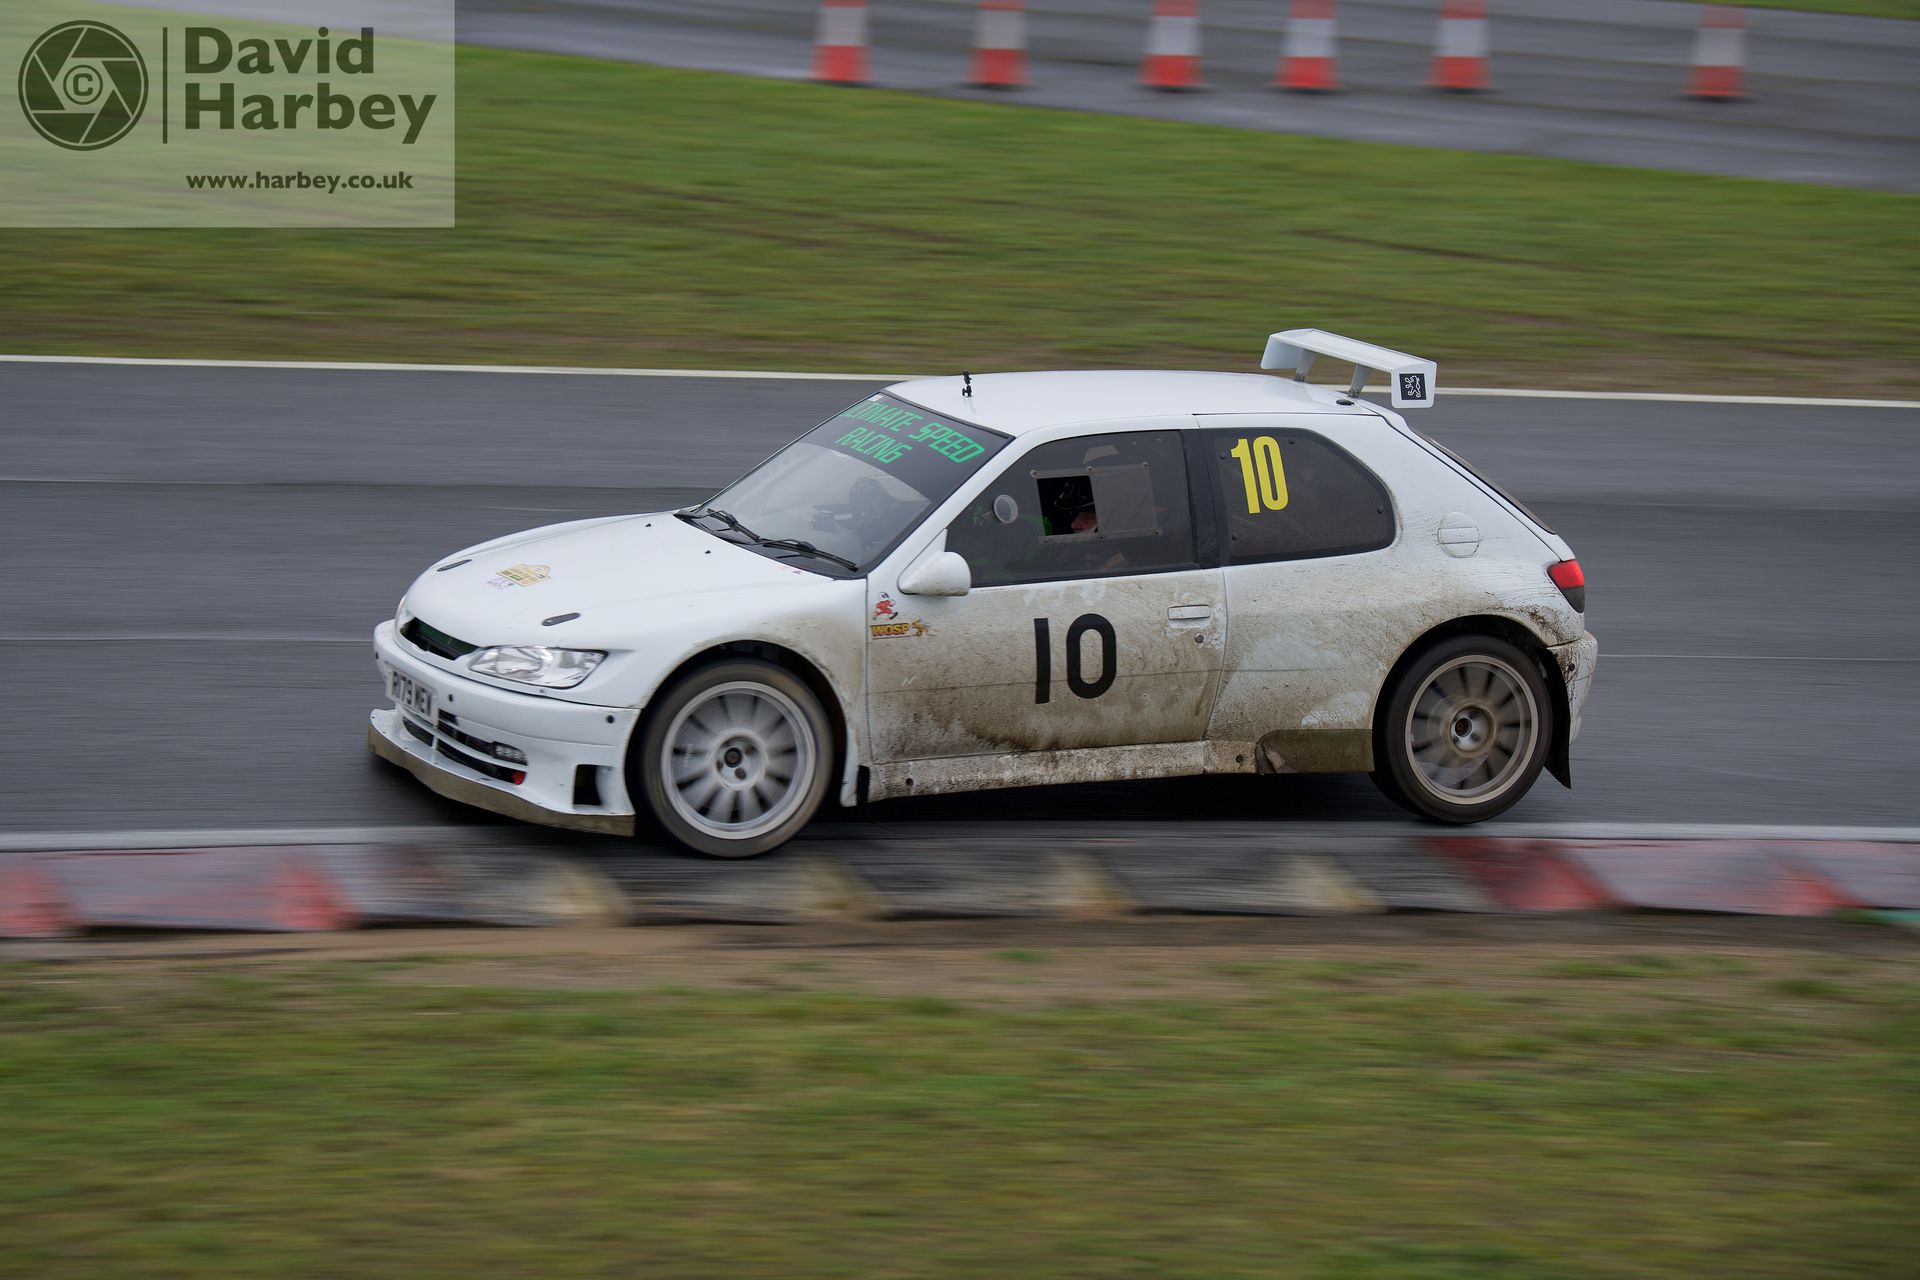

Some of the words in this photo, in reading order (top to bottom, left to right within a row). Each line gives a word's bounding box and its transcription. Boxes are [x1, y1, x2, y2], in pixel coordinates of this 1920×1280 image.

[834, 427, 913, 464] RACING
[907, 422, 985, 463] SPEED
[1230, 435, 1289, 514] 10
[871, 623, 911, 637] WOSP
[1033, 613, 1117, 704] 10
